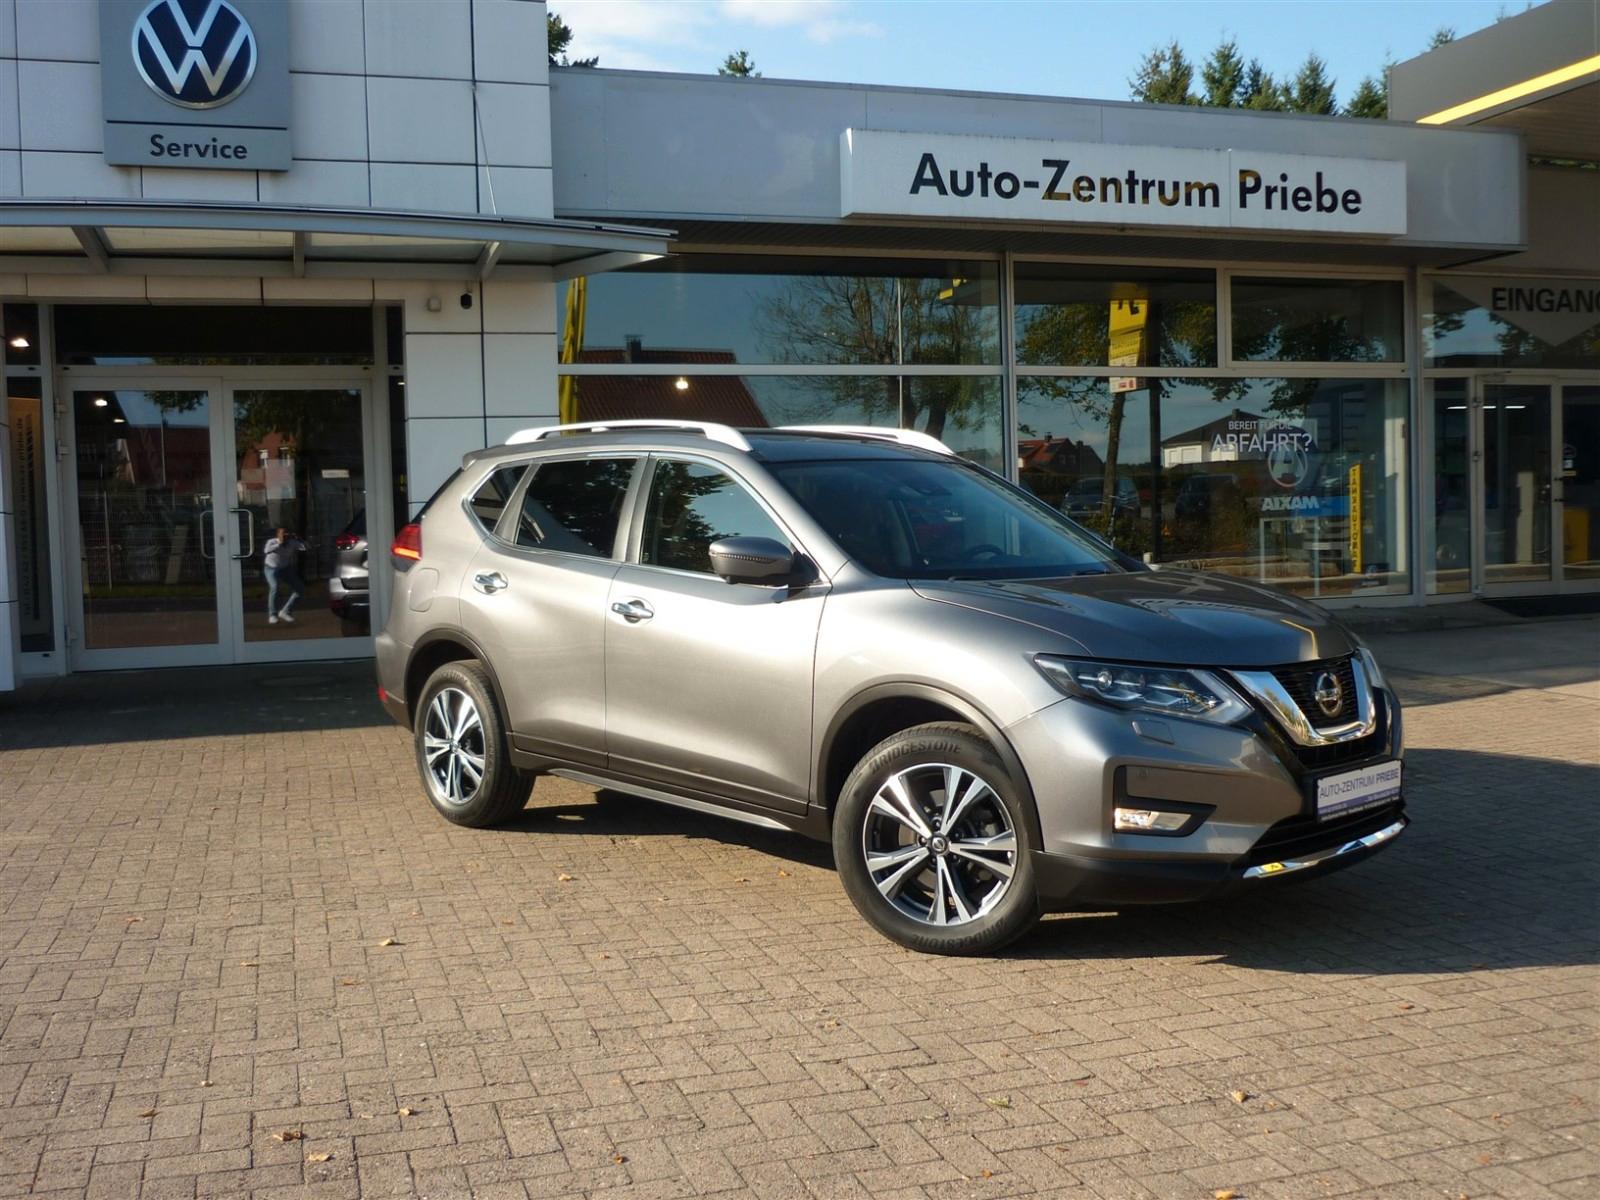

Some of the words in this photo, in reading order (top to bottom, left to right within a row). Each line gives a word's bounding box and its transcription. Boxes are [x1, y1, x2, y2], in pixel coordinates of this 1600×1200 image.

[149, 133, 248, 160] Service
[908, 152, 1220, 208] Auto-Zentrum
[1237, 168, 1363, 215] Priebe
[1491, 286, 1600, 313] EINGAN
[1228, 420, 1259, 431] BEREIT
[1279, 420, 1294, 431] DIE
[1210, 432, 1313, 454] ABFAHRT?
[1261, 495, 1320, 512] AIXAM
[871, 739, 961, 774] BRIDGESTONE
[1319, 775, 1376, 798] AUTO-ZENTRUM
[1376, 767, 1399, 784] PRIEBE
